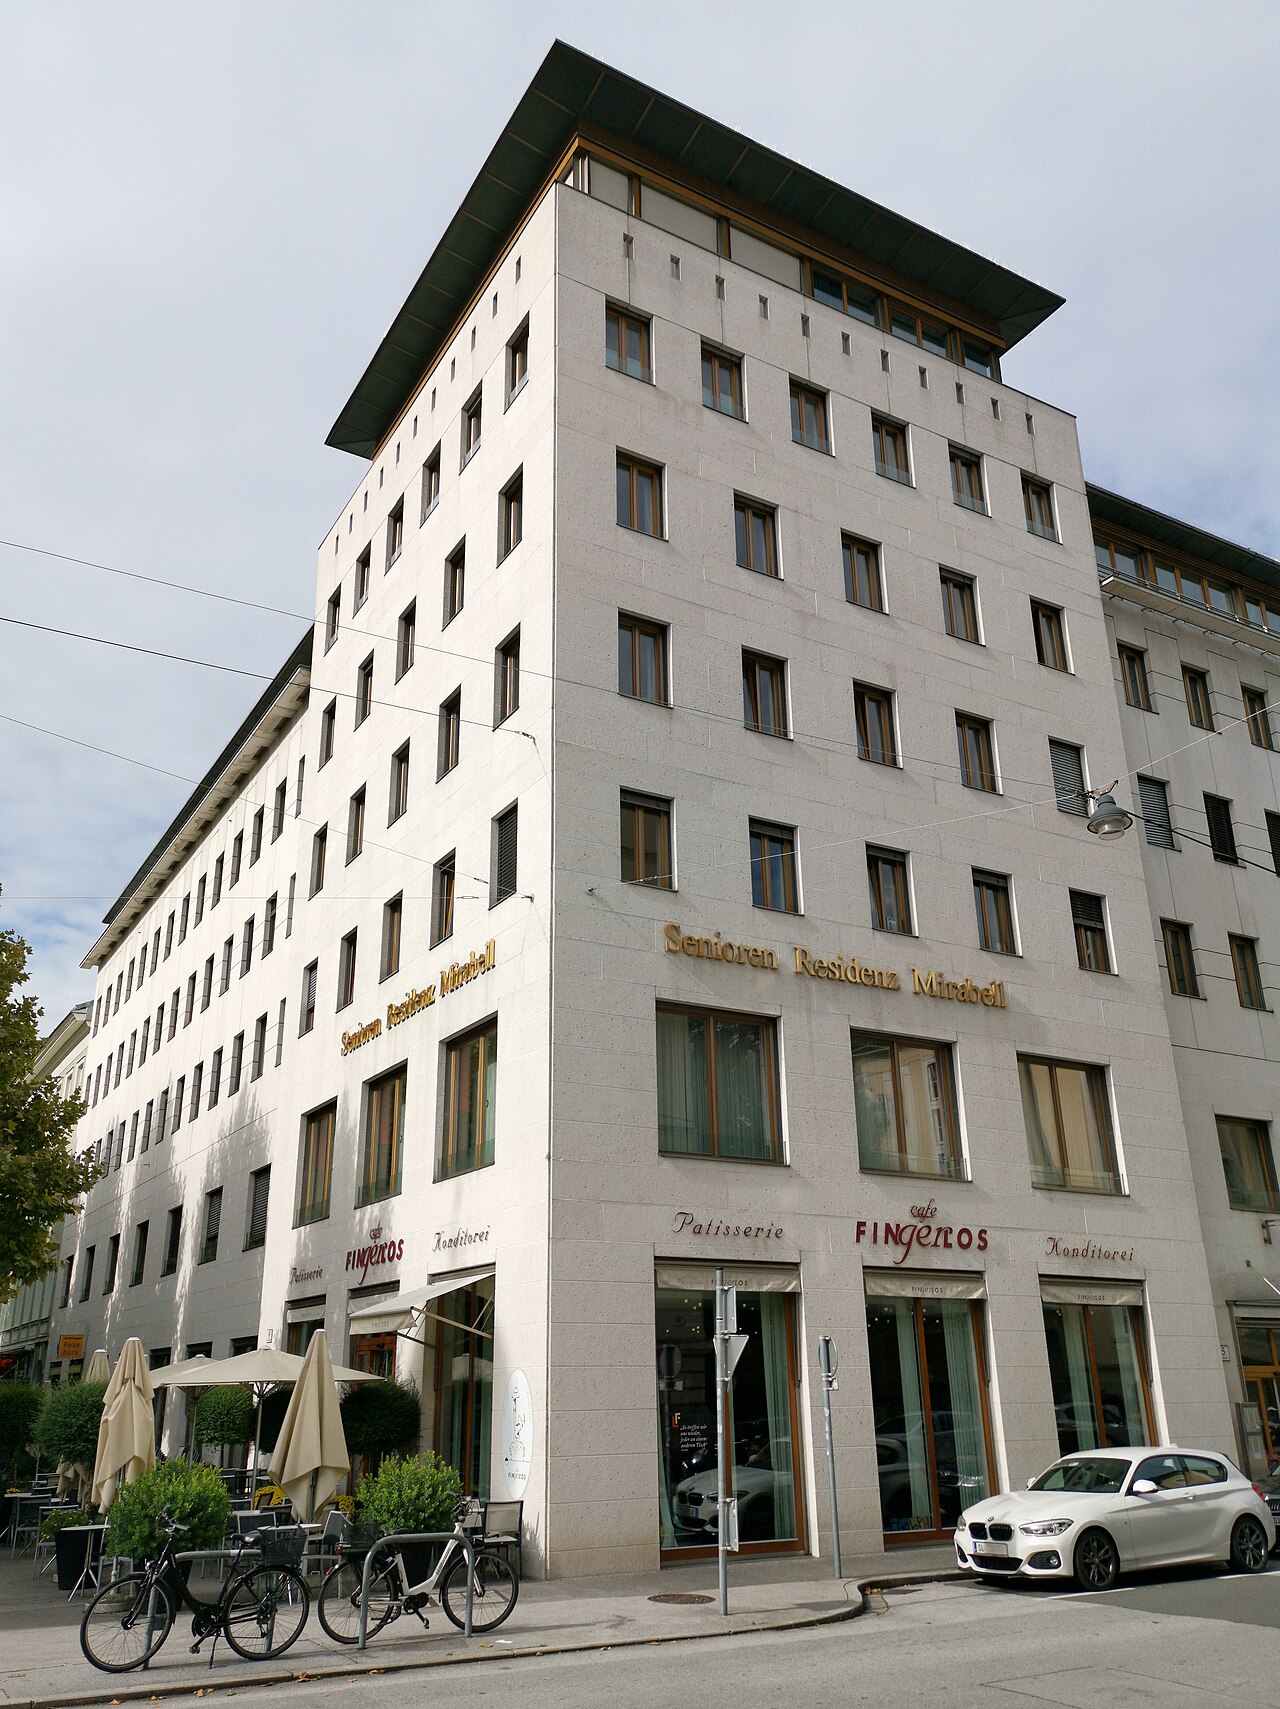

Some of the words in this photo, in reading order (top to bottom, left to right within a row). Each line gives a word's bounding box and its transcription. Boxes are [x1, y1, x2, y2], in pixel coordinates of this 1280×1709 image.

[664, 923, 778, 970] Senioren
[793, 946, 901, 990] Residenz
[912, 968, 1006, 1008] Mirabell
[341, 1018, 382, 1056] Senioren
[386, 984, 436, 1030] Residenz
[439, 938, 496, 998] Mirabell
[910, 1198, 938, 1222] cafe
[432, 1225, 491, 1252] Konditorei
[671, 1211, 785, 1239] Patisserie
[1046, 1237, 1135, 1262] Konditorei
